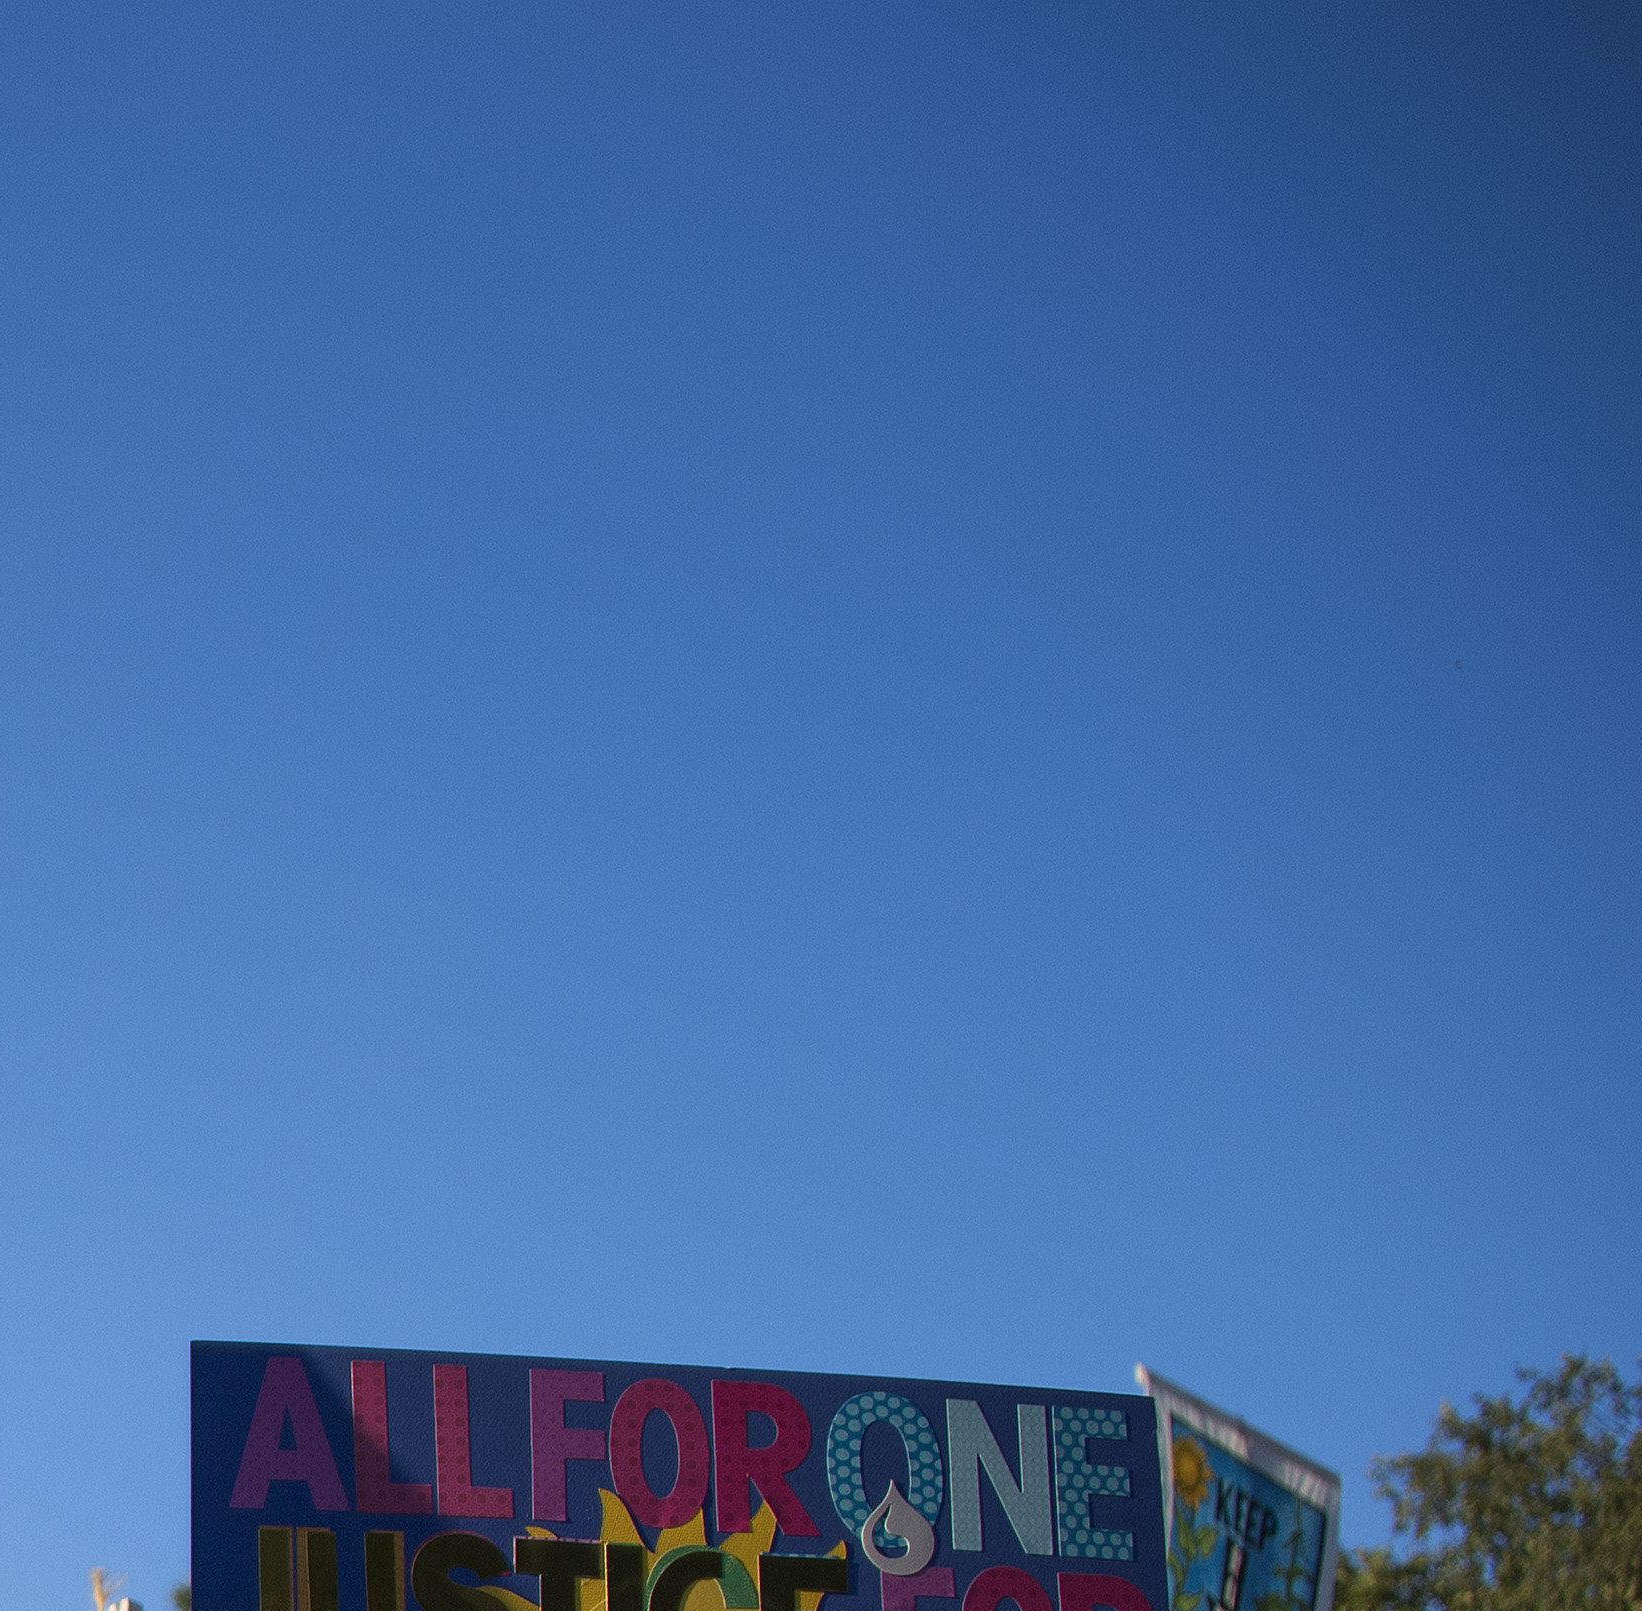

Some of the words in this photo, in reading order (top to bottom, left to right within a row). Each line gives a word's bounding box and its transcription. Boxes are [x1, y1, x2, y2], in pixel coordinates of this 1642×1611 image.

[229, 1357, 515, 1520] ALL
[530, 1368, 824, 1541] FOR
[825, 1390, 1135, 1564] ONE
[1216, 1477, 1280, 1551] KEEP
